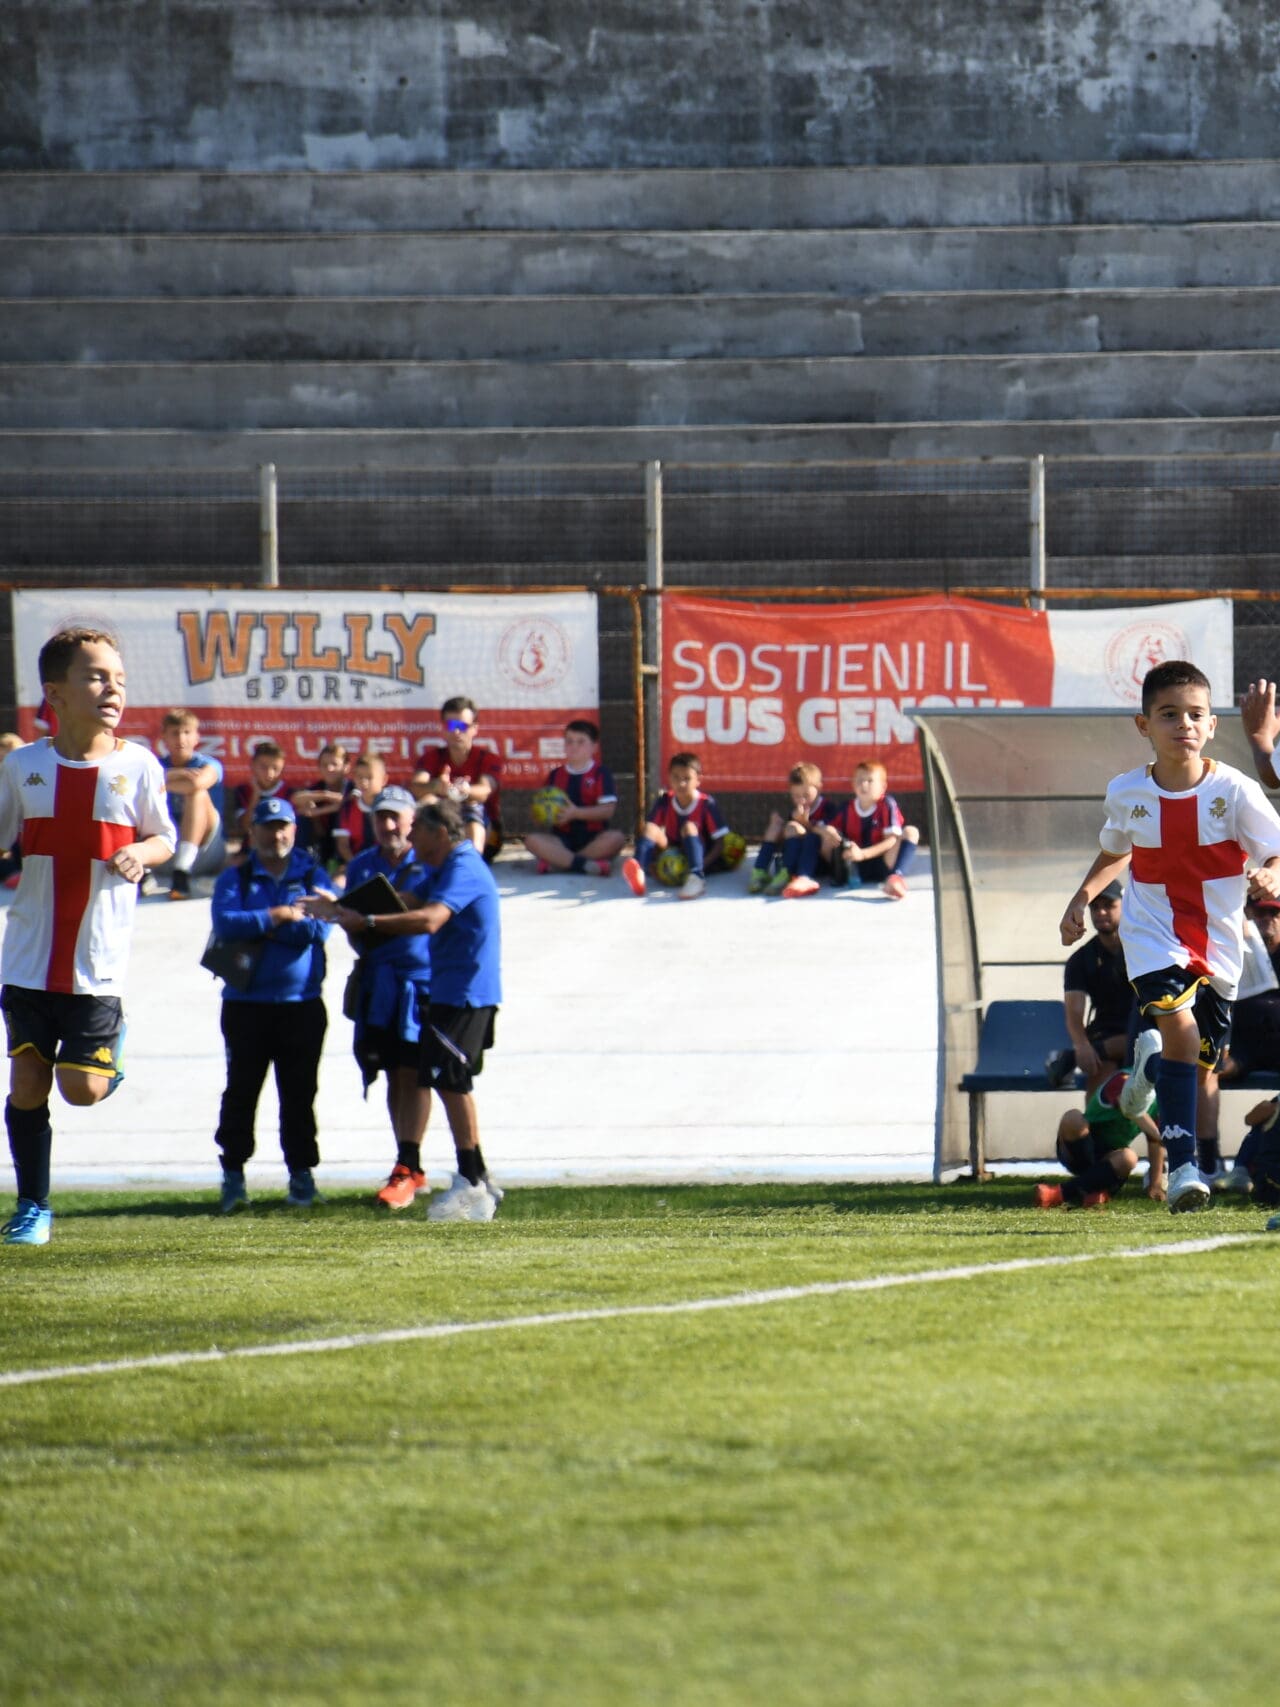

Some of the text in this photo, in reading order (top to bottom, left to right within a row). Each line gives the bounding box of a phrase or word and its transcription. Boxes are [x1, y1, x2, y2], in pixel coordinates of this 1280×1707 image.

[177, 610, 437, 688] WILLY
[671, 639, 988, 693] SOSTIENI IL
[245, 674, 368, 701] SPORT
[670, 694, 1024, 746] CUS GEN
